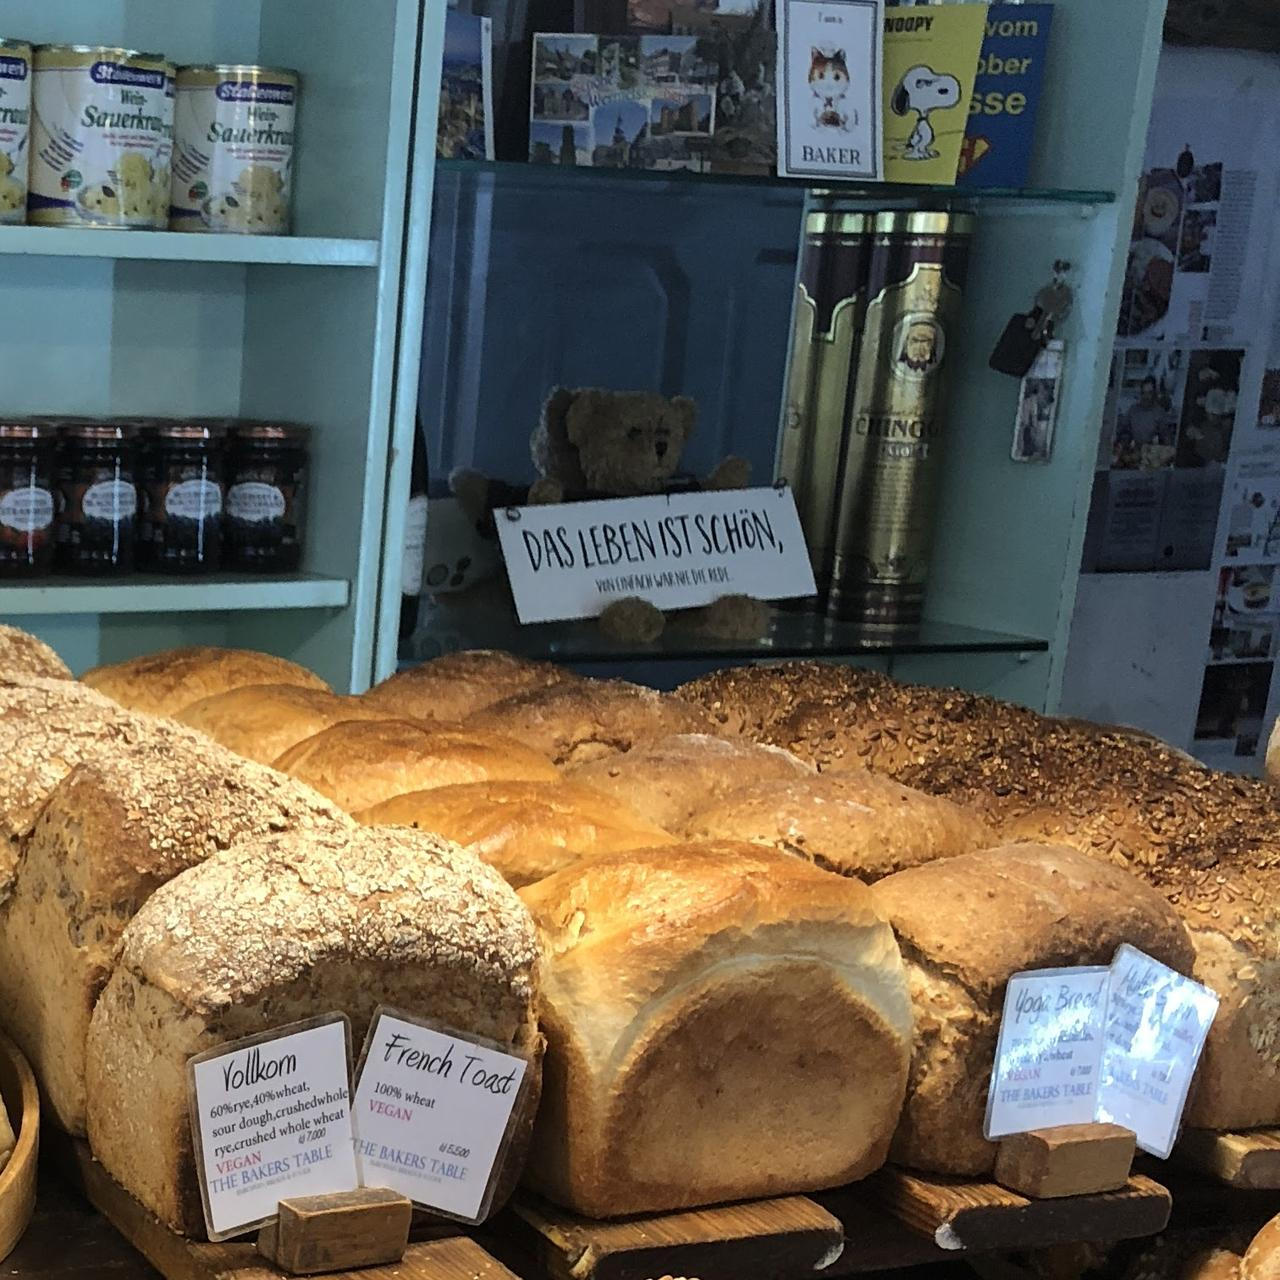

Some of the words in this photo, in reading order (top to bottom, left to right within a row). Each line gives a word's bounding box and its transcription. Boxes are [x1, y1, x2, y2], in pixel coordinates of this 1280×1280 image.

[883, 16, 934, 33] NOOPY
[802, 145, 861, 165] BAKER
[522, 526, 575, 573] DAS
[578, 519, 657, 569] LEBEN
[658, 514, 690, 558] IST
[694, 508, 784, 555] SCHÖN,
[1014, 988, 1050, 1024] Yoga
[383, 1032, 455, 1079] French
[459, 1055, 517, 1095] Toast
[369, 1099, 414, 1121] VEGAN
[373, 1081, 402, 1100] 100%
[405, 1091, 436, 1109] wheat
[212, 1122, 237, 1138] sour
[214, 1128, 277, 1158] rye,crushed
[279, 1118, 311, 1137] whole
[312, 1108, 345, 1127] wheat
[209, 1175, 238, 1194] THE
[240, 1157, 290, 1185] BAKERS
[292, 1145, 333, 1168] TABLE
[215, 1151, 263, 1174] VEGAN
[350, 1137, 376, 1157] THE
[379, 1145, 426, 1170] BAKERS
[429, 1157, 469, 1181] TABLE
